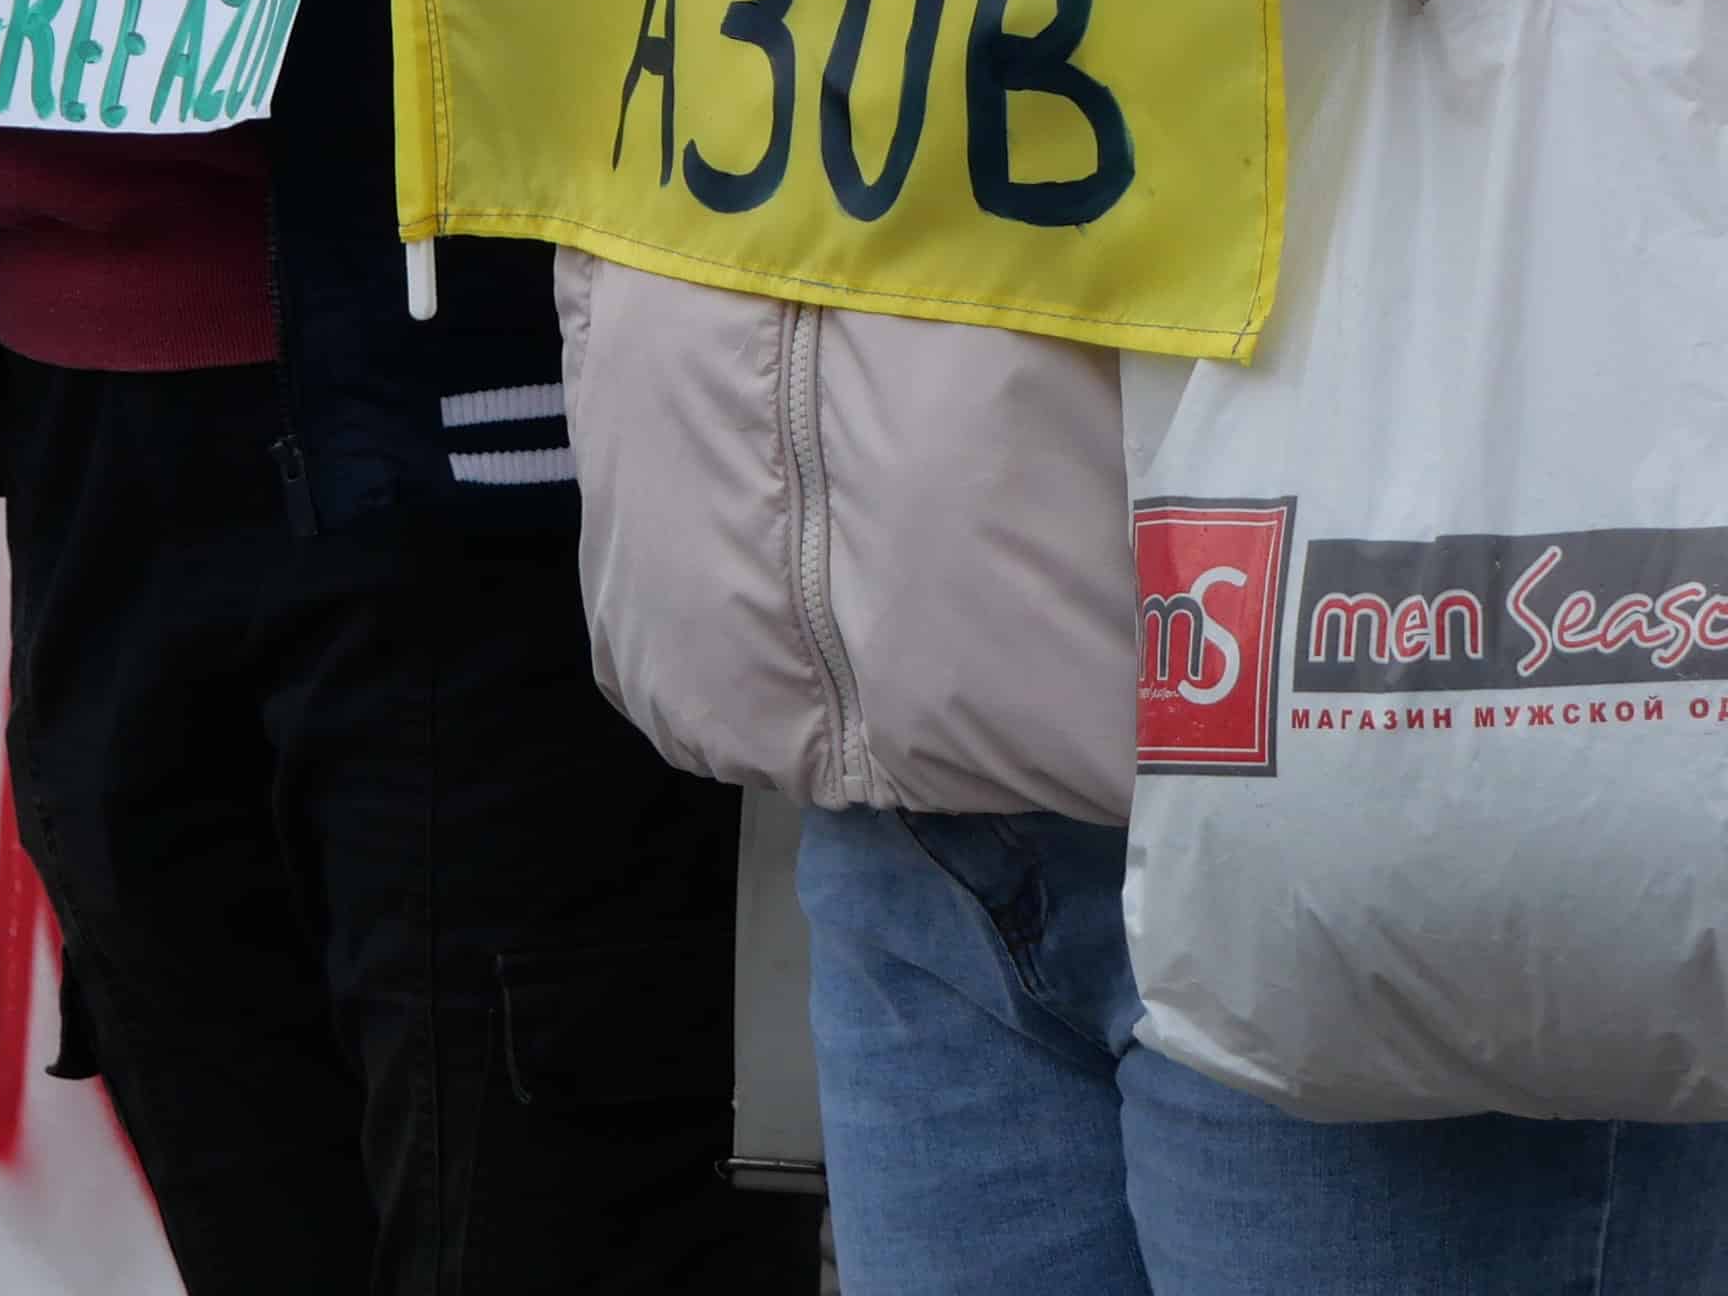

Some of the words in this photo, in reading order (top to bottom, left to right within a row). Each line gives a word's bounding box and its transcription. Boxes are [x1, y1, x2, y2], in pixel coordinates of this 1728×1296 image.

[1307, 588, 1483, 663] men
[1290, 707, 1453, 731] МАГАЗИН
[1474, 694, 1665, 729] МУЖСКОЙ
